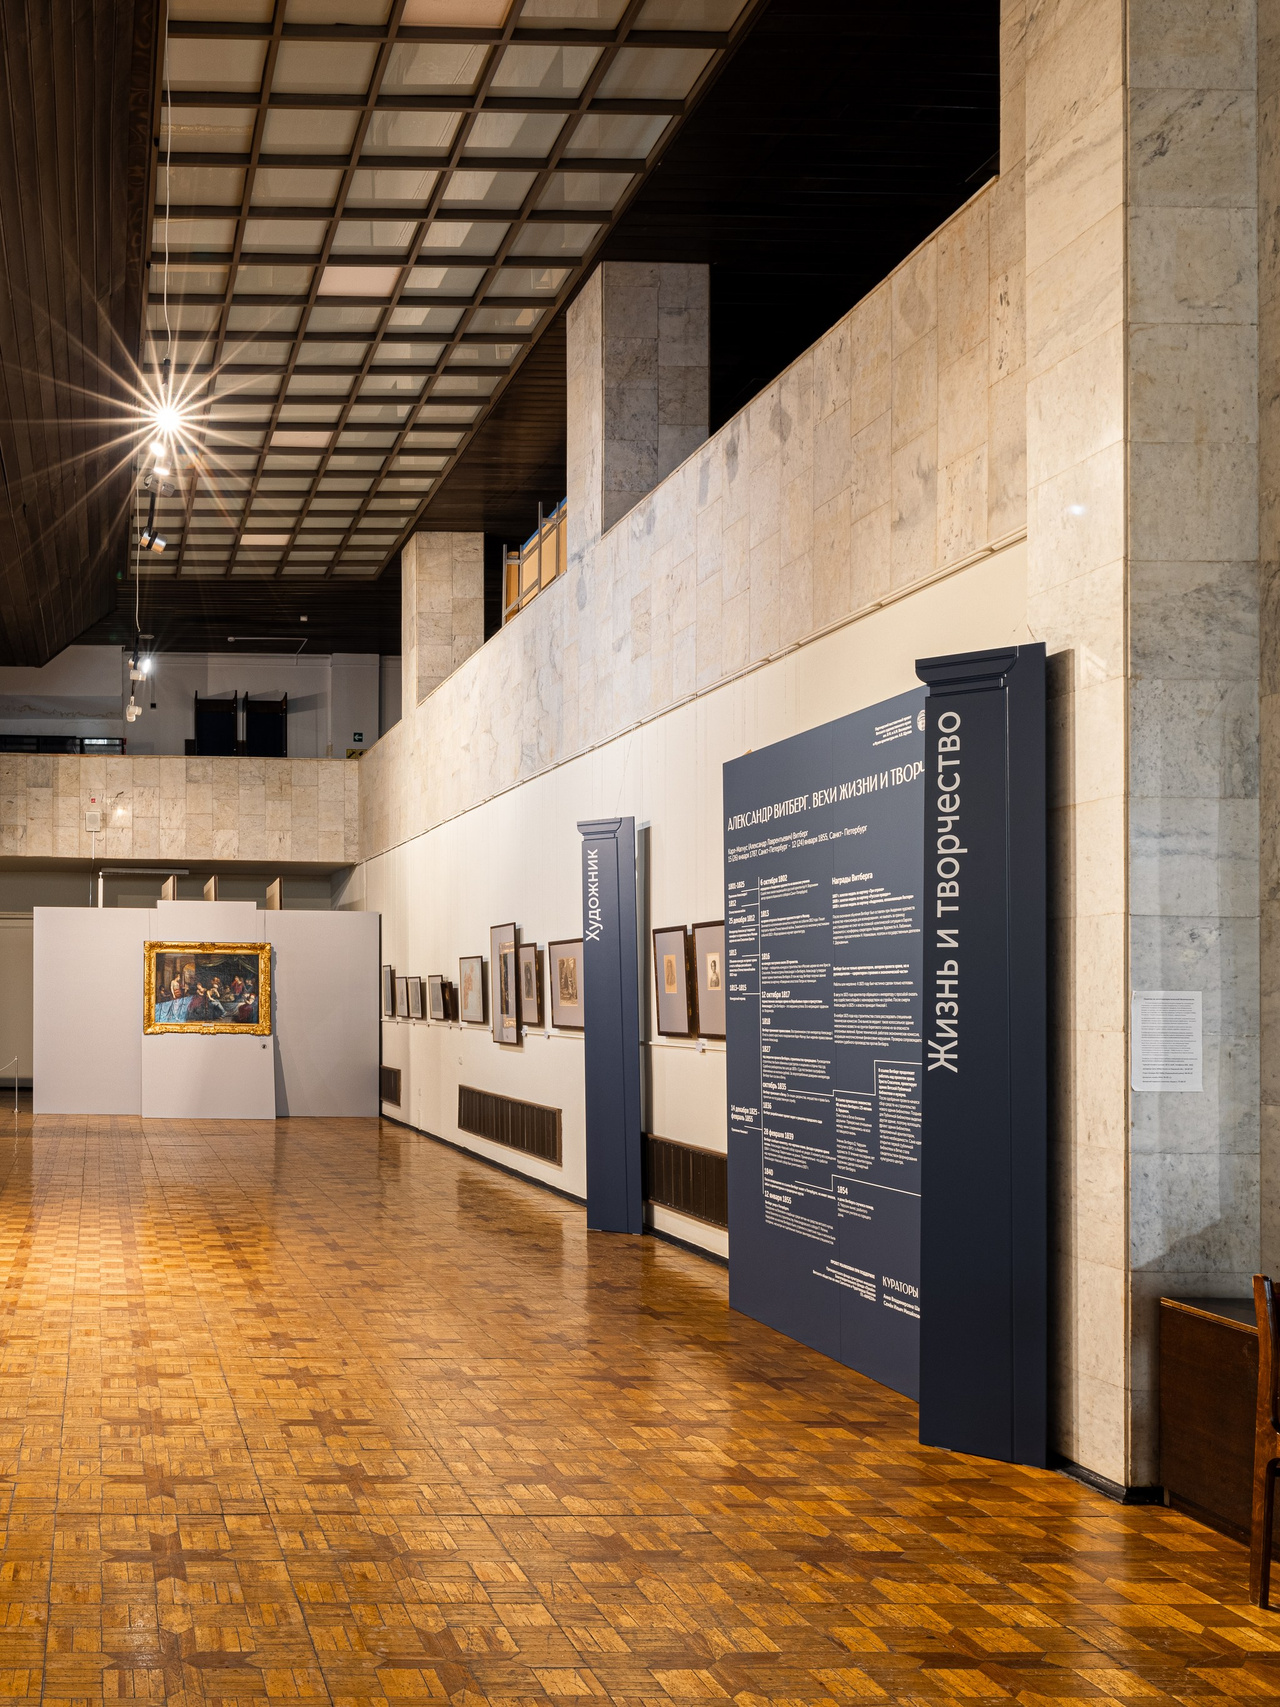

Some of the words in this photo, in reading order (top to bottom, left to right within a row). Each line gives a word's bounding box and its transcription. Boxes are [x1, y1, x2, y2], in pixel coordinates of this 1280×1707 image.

[728, 806, 773, 831] АЛЕКСАНДР
[813, 786, 837, 808] ВЕХИ
[839, 774, 877, 800] ЖИЗНИ
[880, 771, 888, 789] И
[937, 712, 967, 916] творчество
[585, 848, 603, 942] Художник
[851, 872, 873, 882] Витберга
[937, 930, 958, 947] и
[928, 960, 958, 1073] Жизнь
[883, 1276, 918, 1298] КУРАТОРЫ
